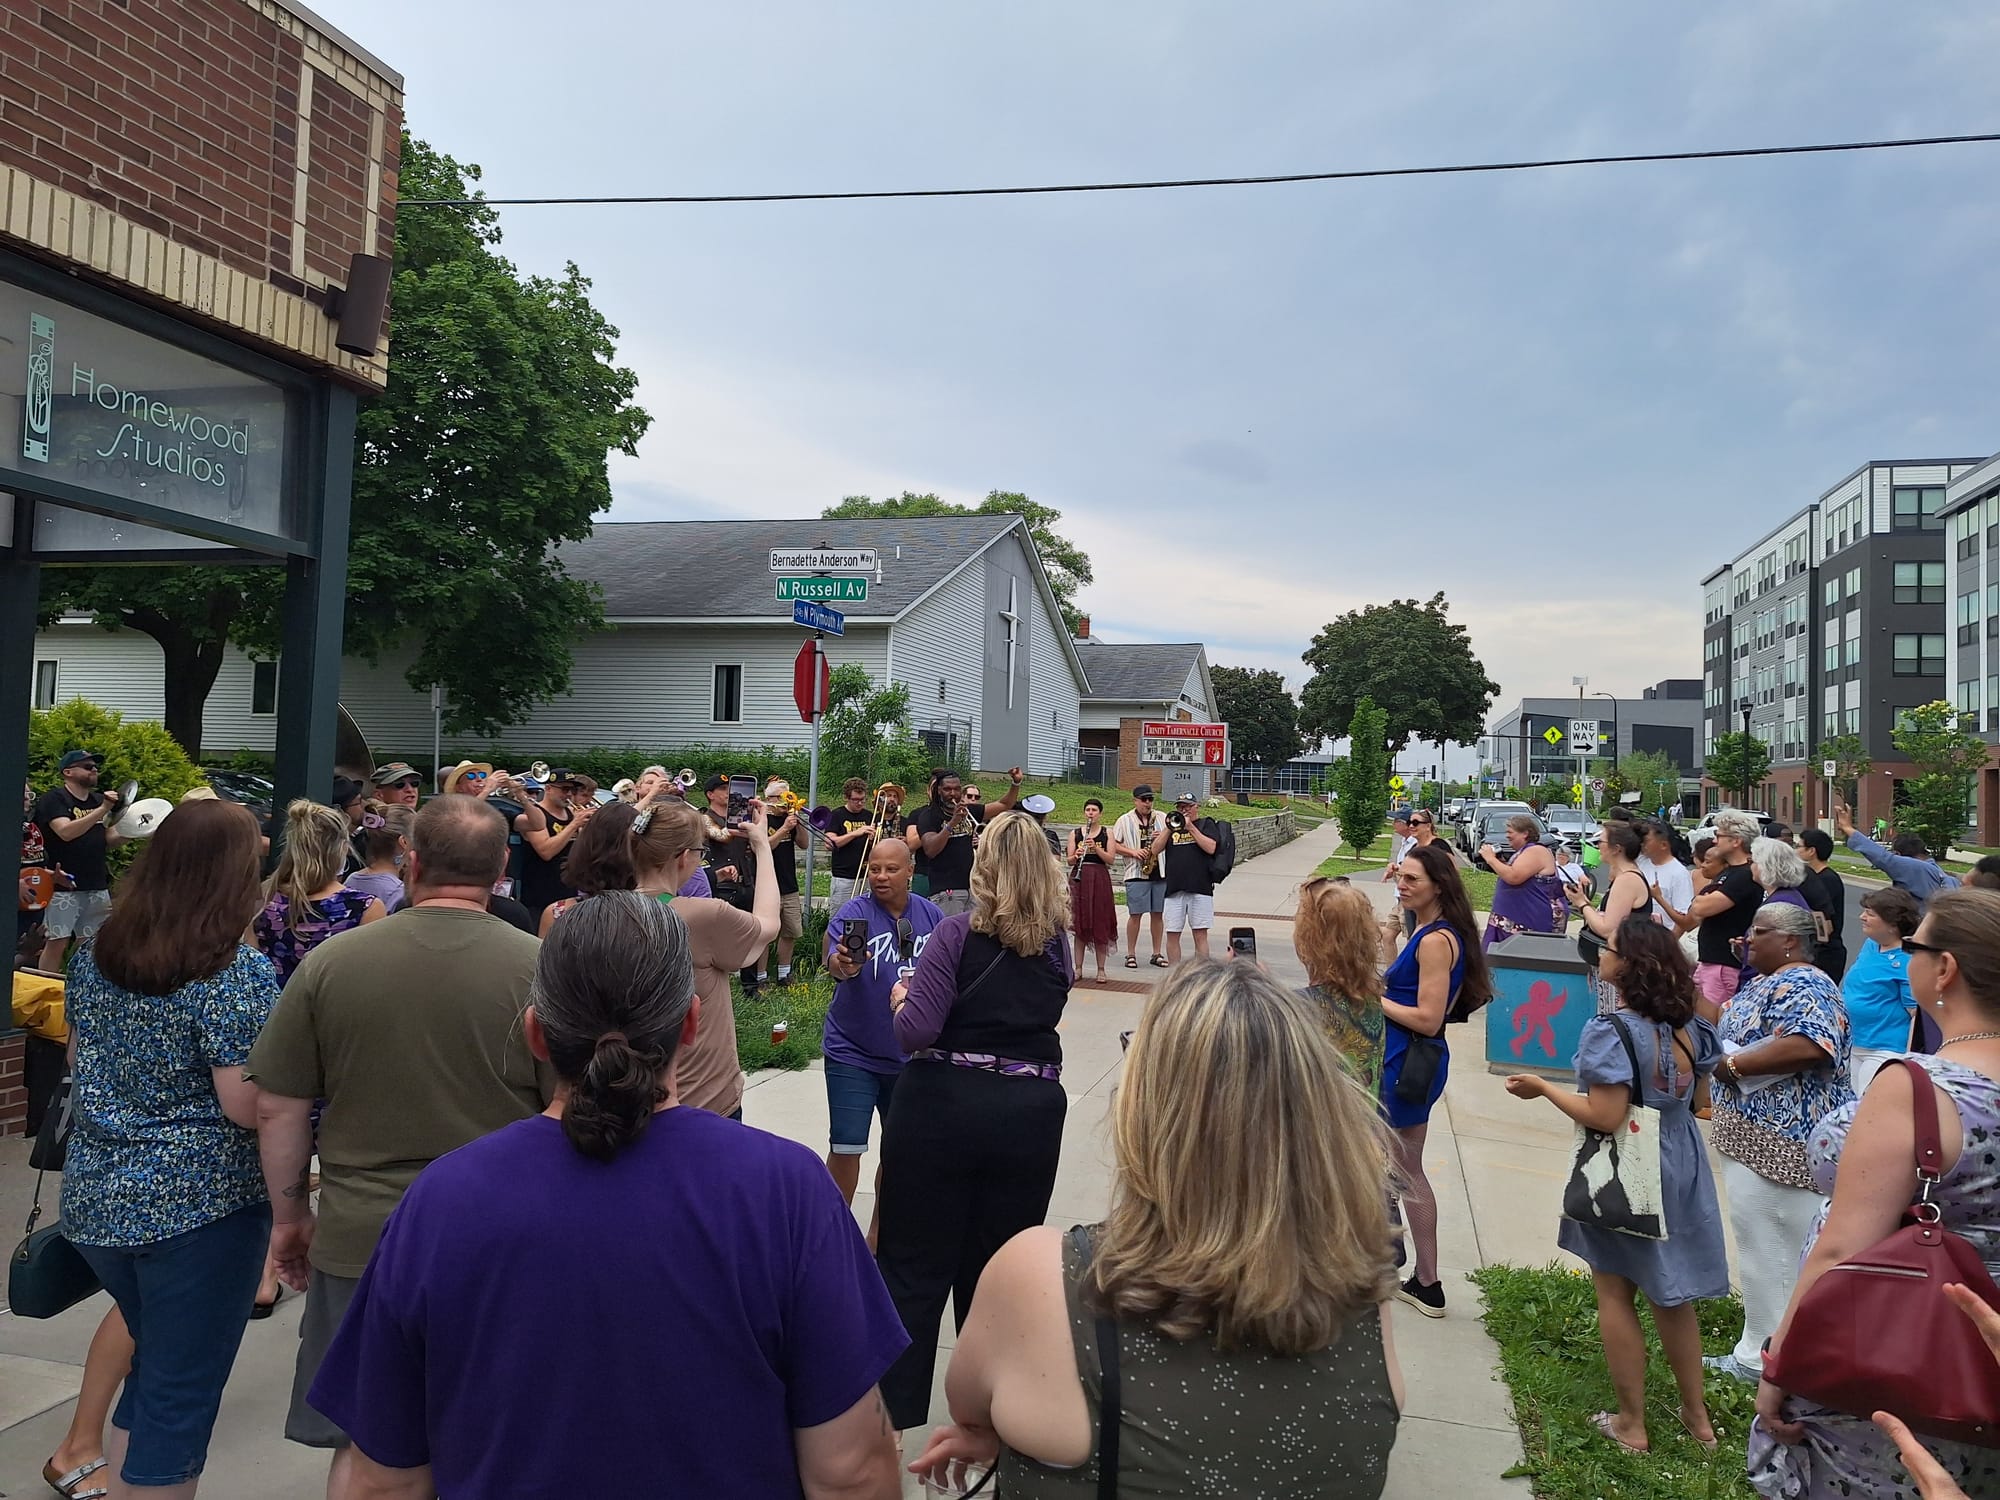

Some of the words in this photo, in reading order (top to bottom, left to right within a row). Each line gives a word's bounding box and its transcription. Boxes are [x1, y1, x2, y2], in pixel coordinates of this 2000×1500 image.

[72, 361, 249, 456] Homewood
[96, 423, 226, 487] Studios
[772, 553, 817, 567] Bernadette
[819, 553, 858, 567] Anderson
[860, 553, 873, 564] Way
[778, 582, 787, 596] N
[792, 582, 840, 596] Russell
[846, 583, 864, 596] Av
[804, 605, 809, 622] N
[809, 607, 836, 629] Plymouth
[1573, 722, 1595, 731] ONE
[1572, 732, 1595, 741] WAY
